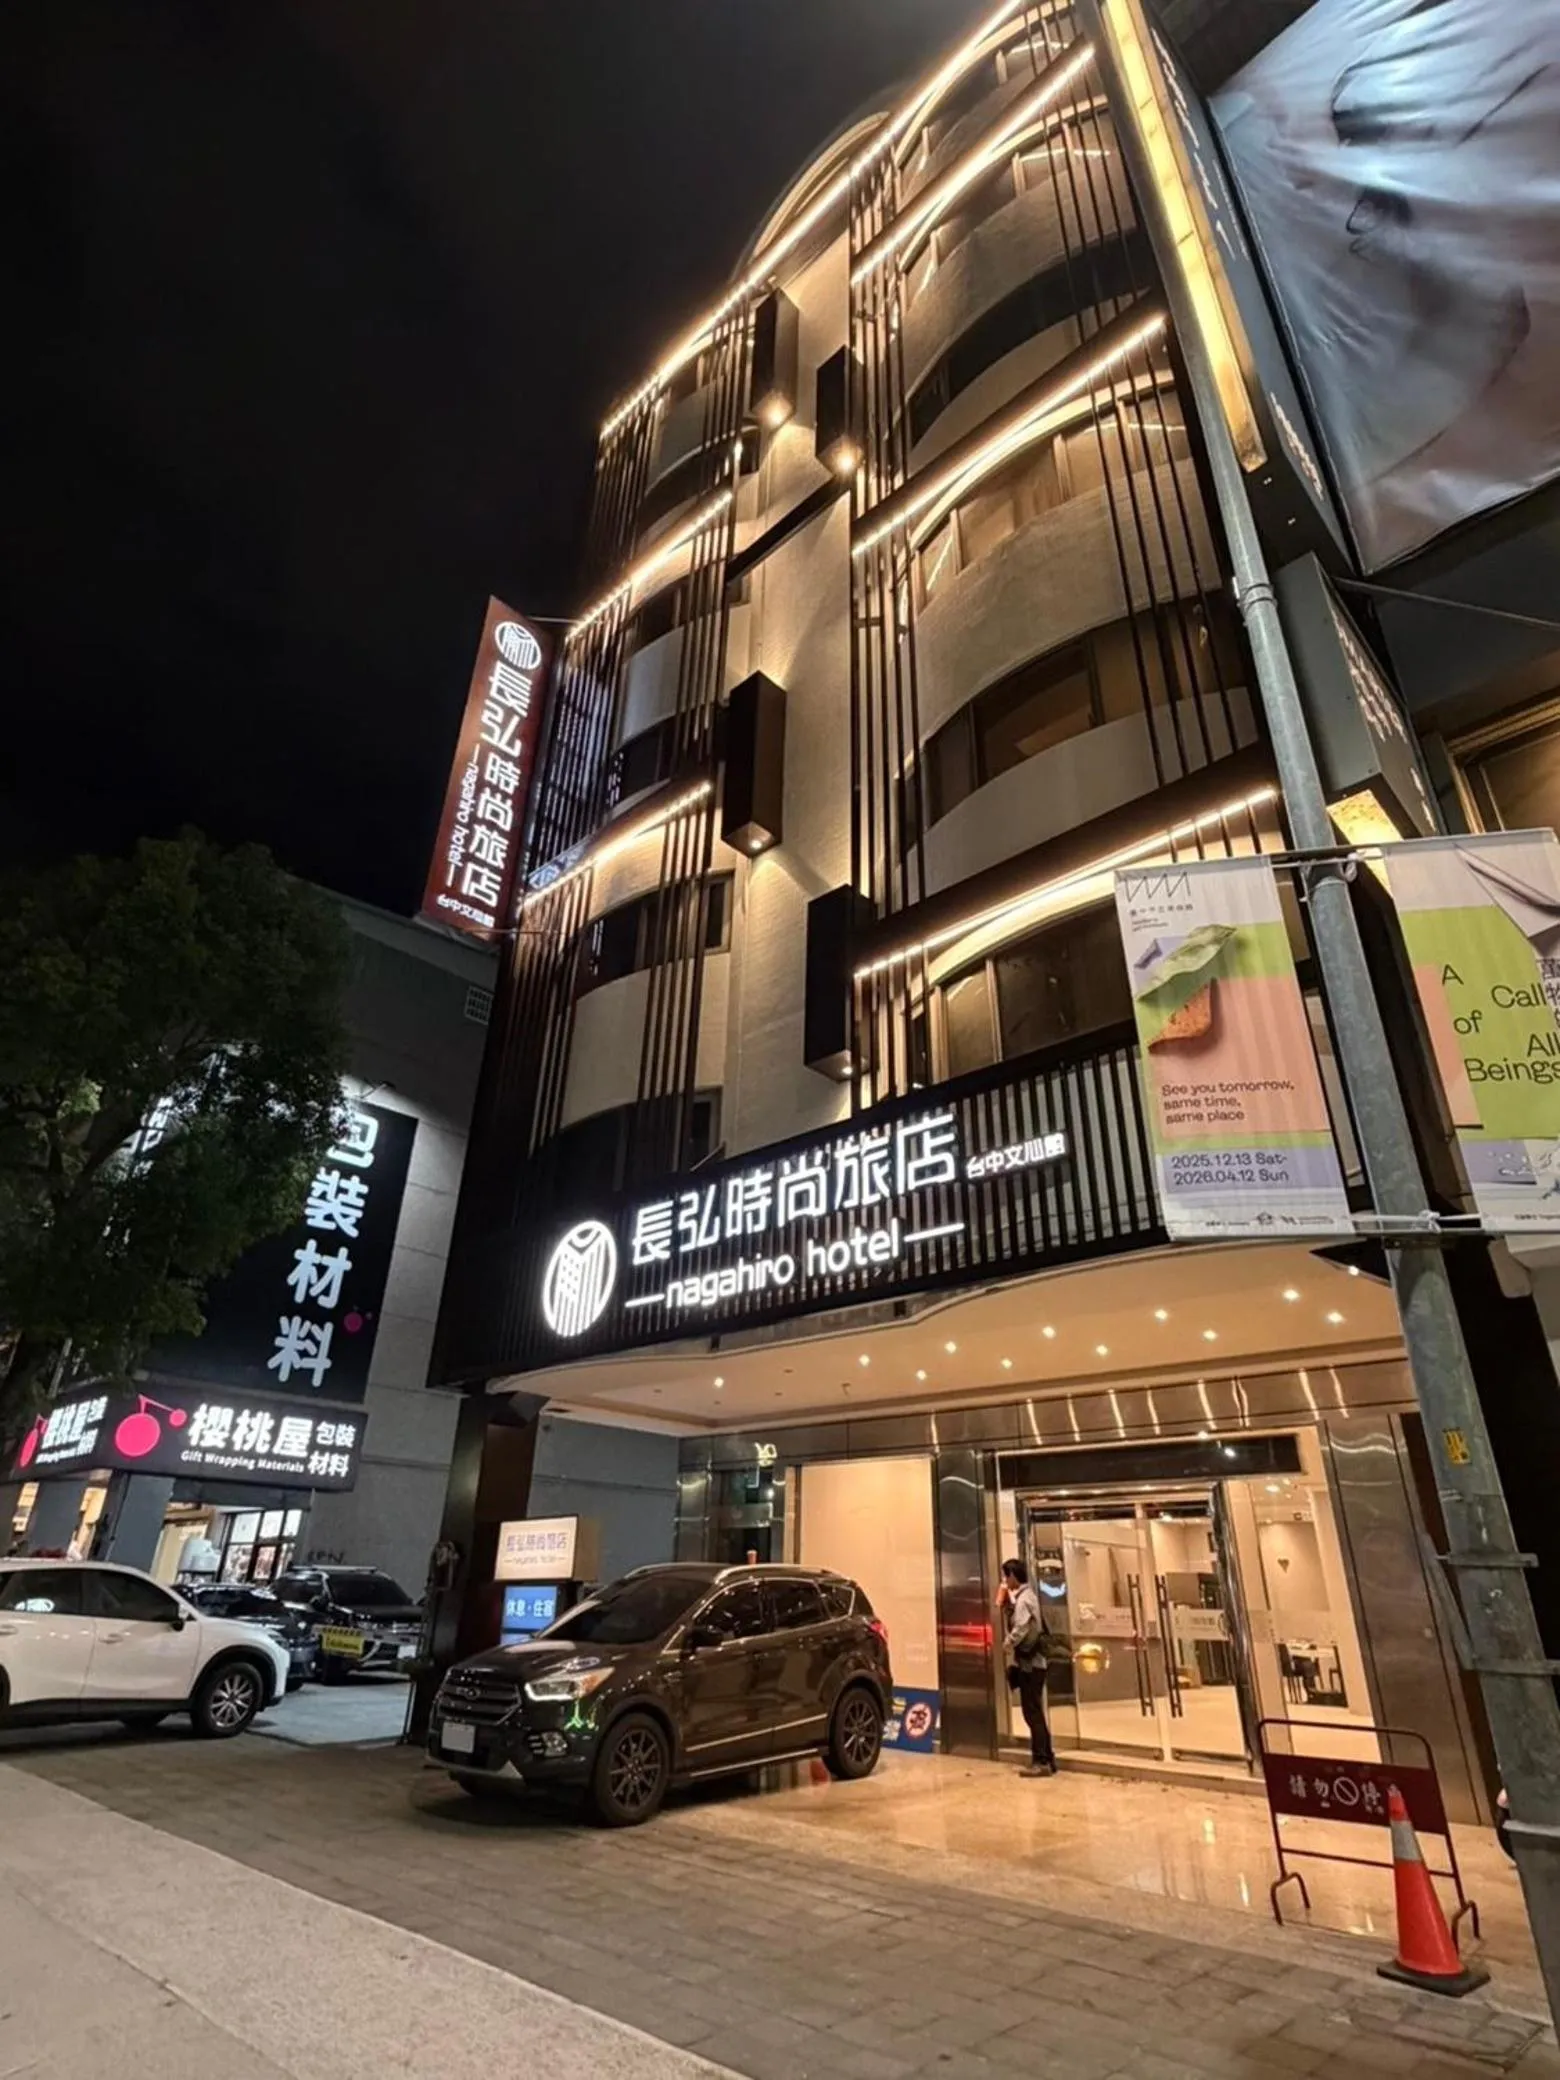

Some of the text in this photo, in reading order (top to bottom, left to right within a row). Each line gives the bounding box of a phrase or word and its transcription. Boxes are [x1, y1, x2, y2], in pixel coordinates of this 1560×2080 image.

[460, 660, 532, 908] 長弘時尚旅店
[447, 762, 478, 868] nagahiro hotel
[1442, 964, 1464, 985] A
[1490, 983, 1548, 1009] Call
[1453, 1009, 1483, 1035] of
[1527, 1032, 1560, 1057] All
[1162, 1079, 1295, 1097] See you tomorrow,
[1163, 1098, 1201, 1110] same
[1166, 1109, 1245, 1125] same place
[1171, 1153, 1252, 1169] 2025.12.13
[632, 1113, 955, 1266] 長弘時尚旅店
[1174, 1168, 1289, 1185] 2026.04.12 Sun
[666, 1218, 899, 1309] nagahiro hotel
[188, 1403, 313, 1458] 櫻桃屋
[316, 1421, 356, 1448] 包裝
[181, 1450, 305, 1473] Gift Wrapping Materials
[308, 1451, 350, 1478] 材料
